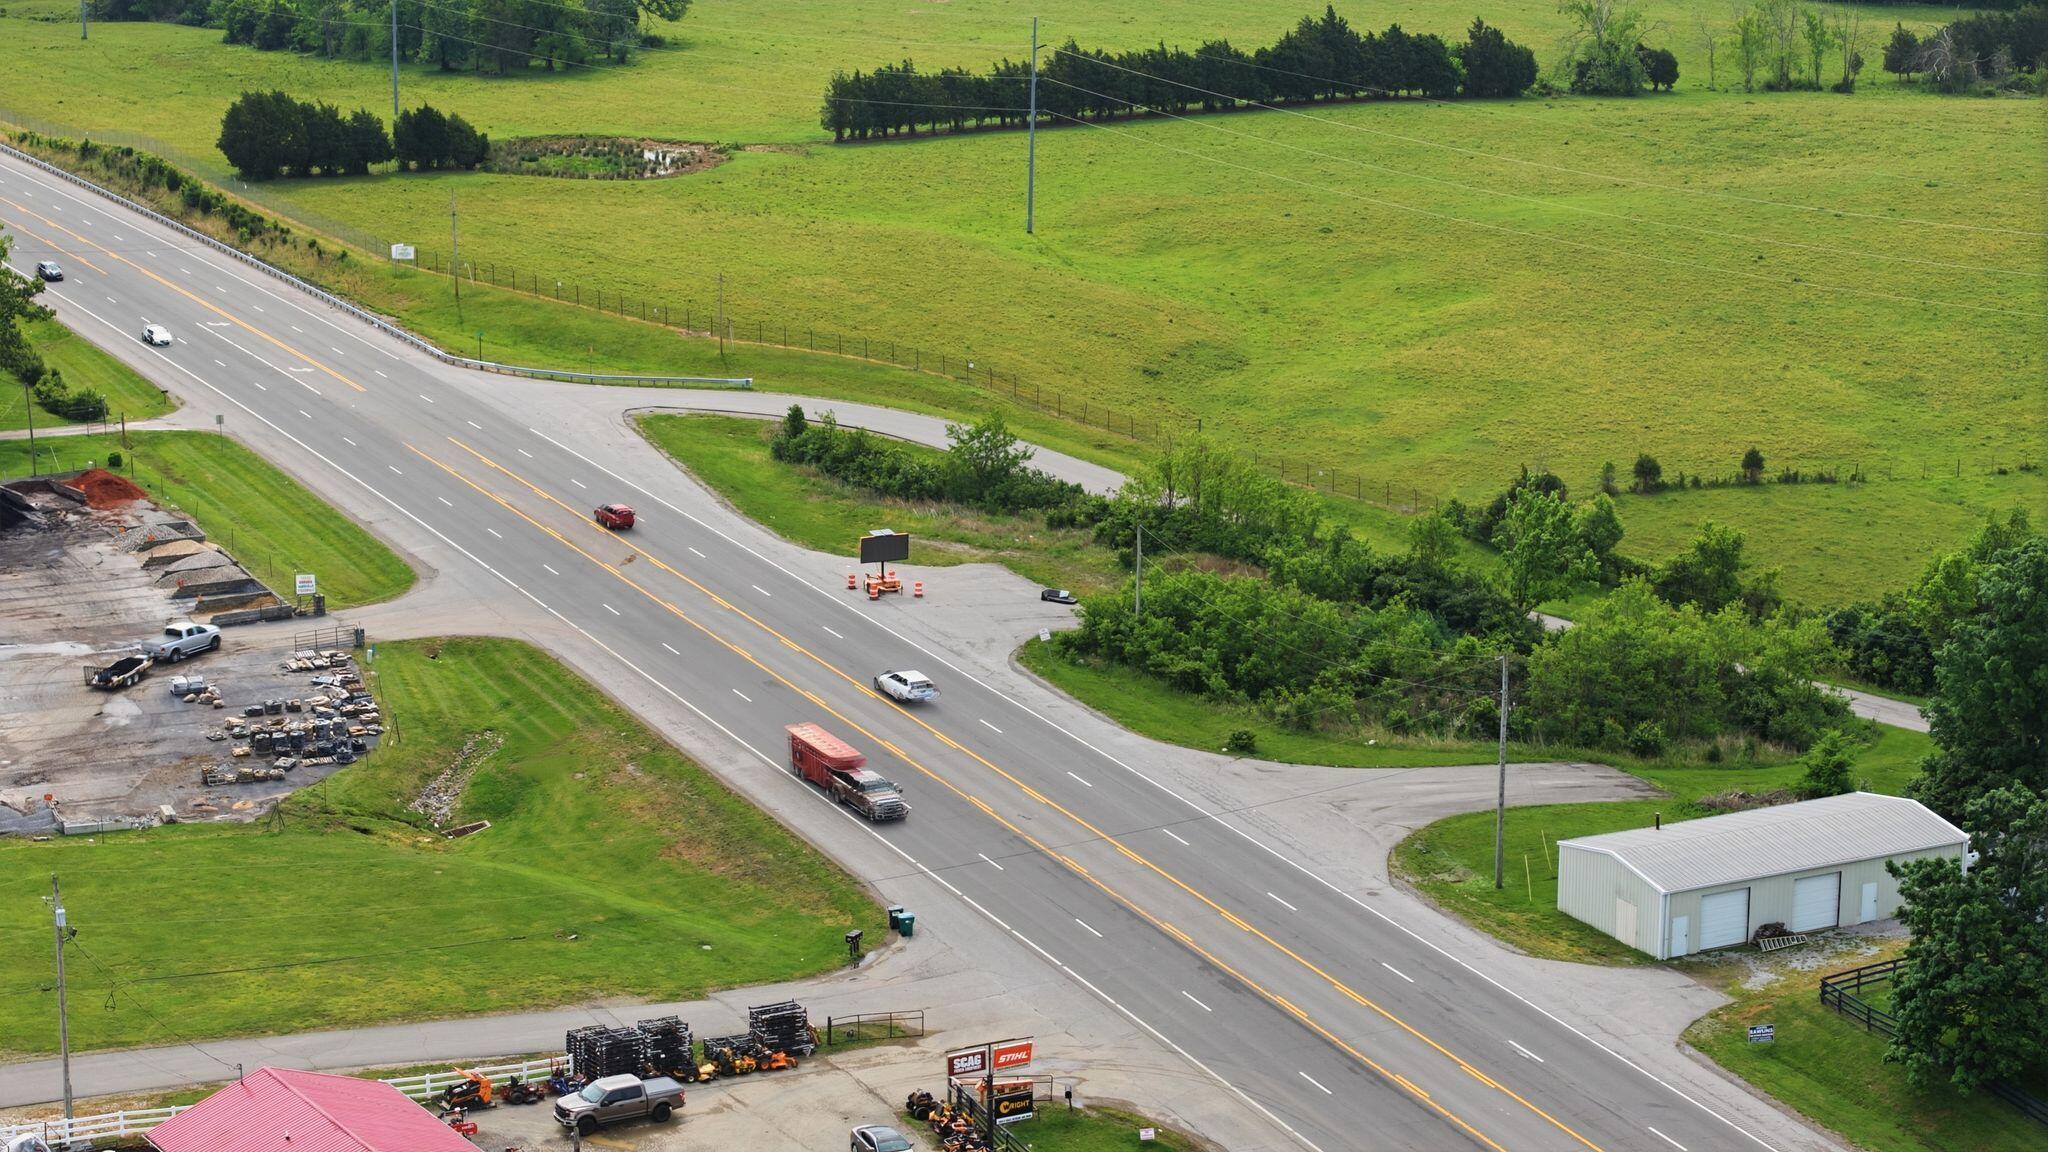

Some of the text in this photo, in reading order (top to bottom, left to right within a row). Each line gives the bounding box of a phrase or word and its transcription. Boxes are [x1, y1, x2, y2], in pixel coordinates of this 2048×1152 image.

[954, 1055, 981, 1068] SCAG
[998, 1051, 1028, 1063] STIHL
[999, 1099, 1030, 1114] WRIGHT
